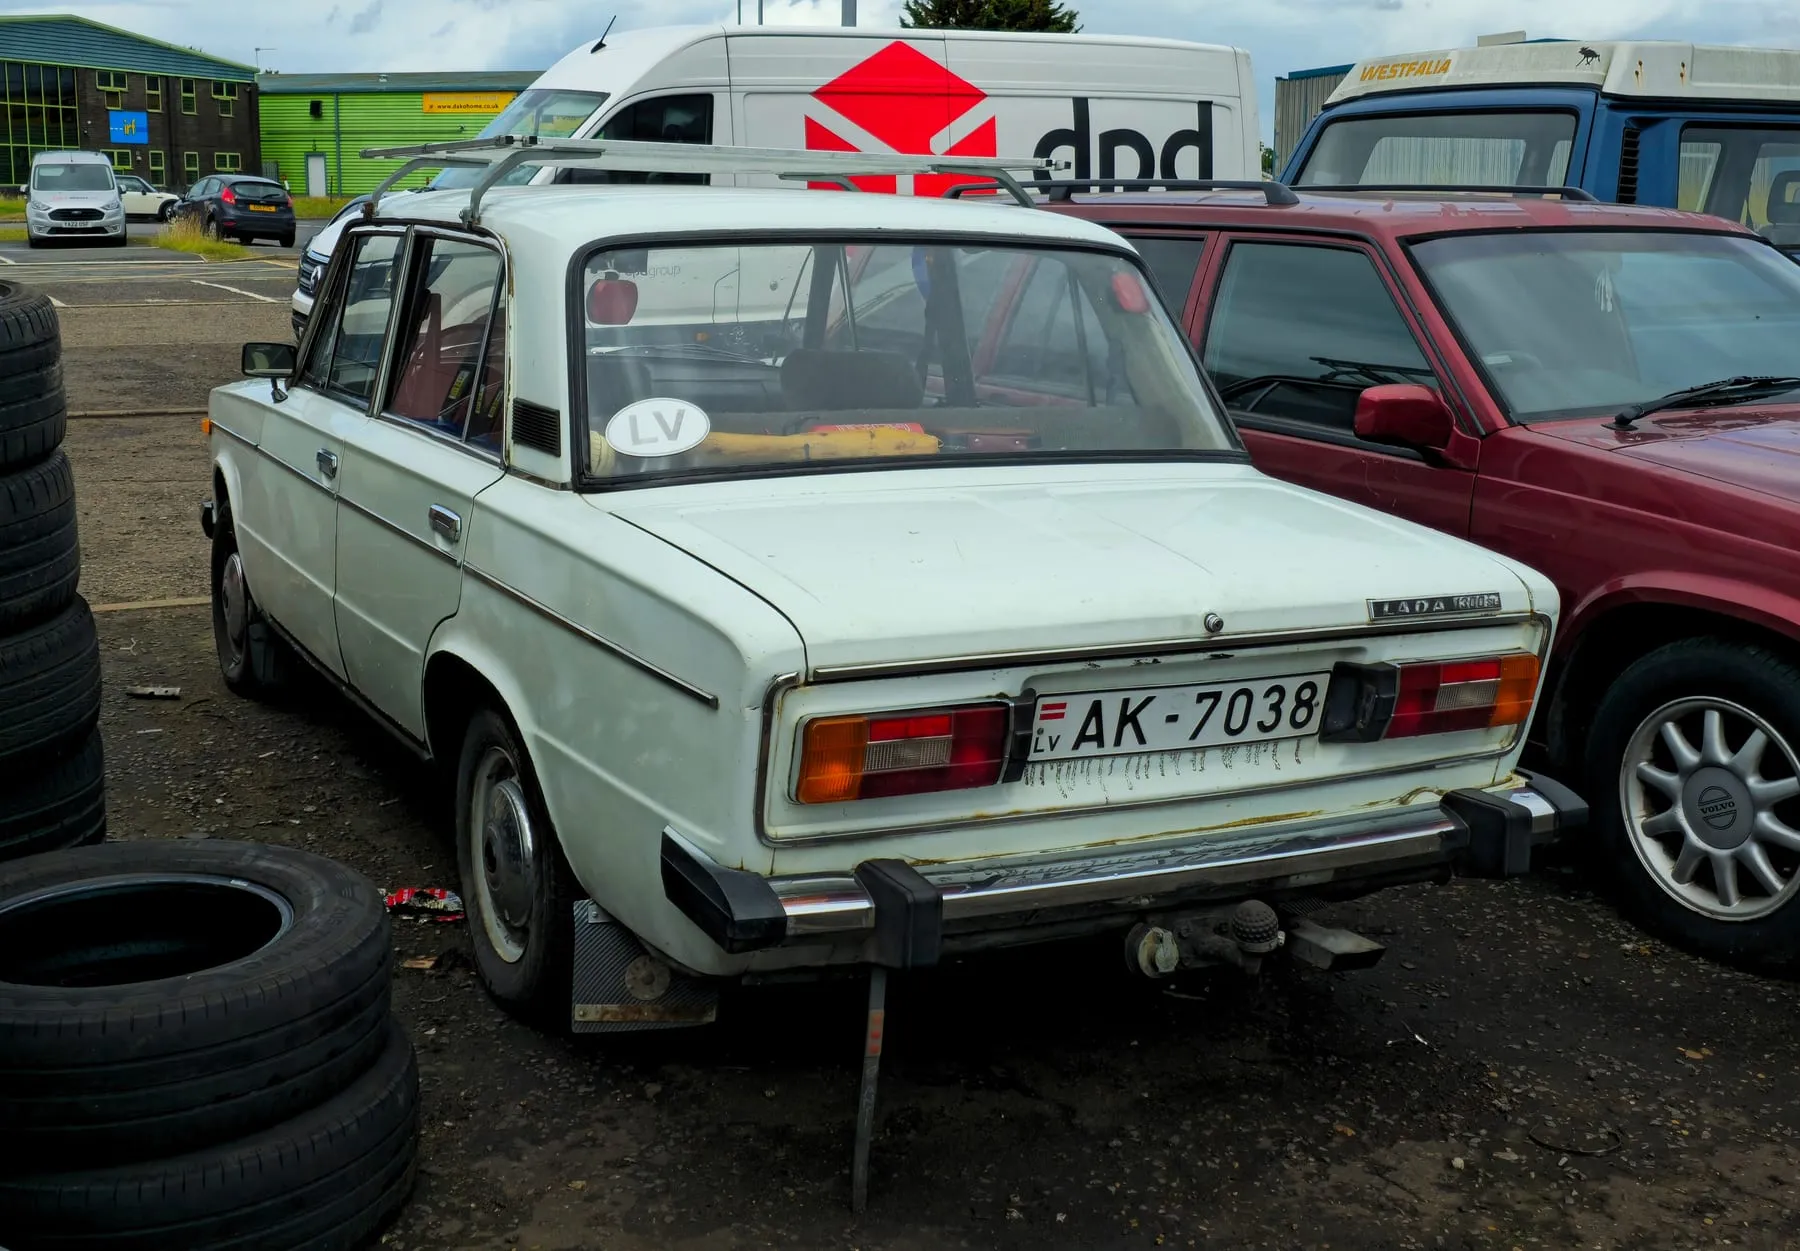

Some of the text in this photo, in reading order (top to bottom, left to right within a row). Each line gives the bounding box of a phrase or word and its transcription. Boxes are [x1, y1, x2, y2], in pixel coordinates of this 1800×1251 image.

[1360, 59, 1452, 81] WESTFALIA
[1033, 96, 1213, 193] dpd
[628, 408, 686, 446] LV
[1383, 599, 1446, 616] LADA
[1071, 681, 1318, 751] AK-7038
[1033, 735, 1061, 753] LV
[1700, 801, 1735, 814] VOLVO
